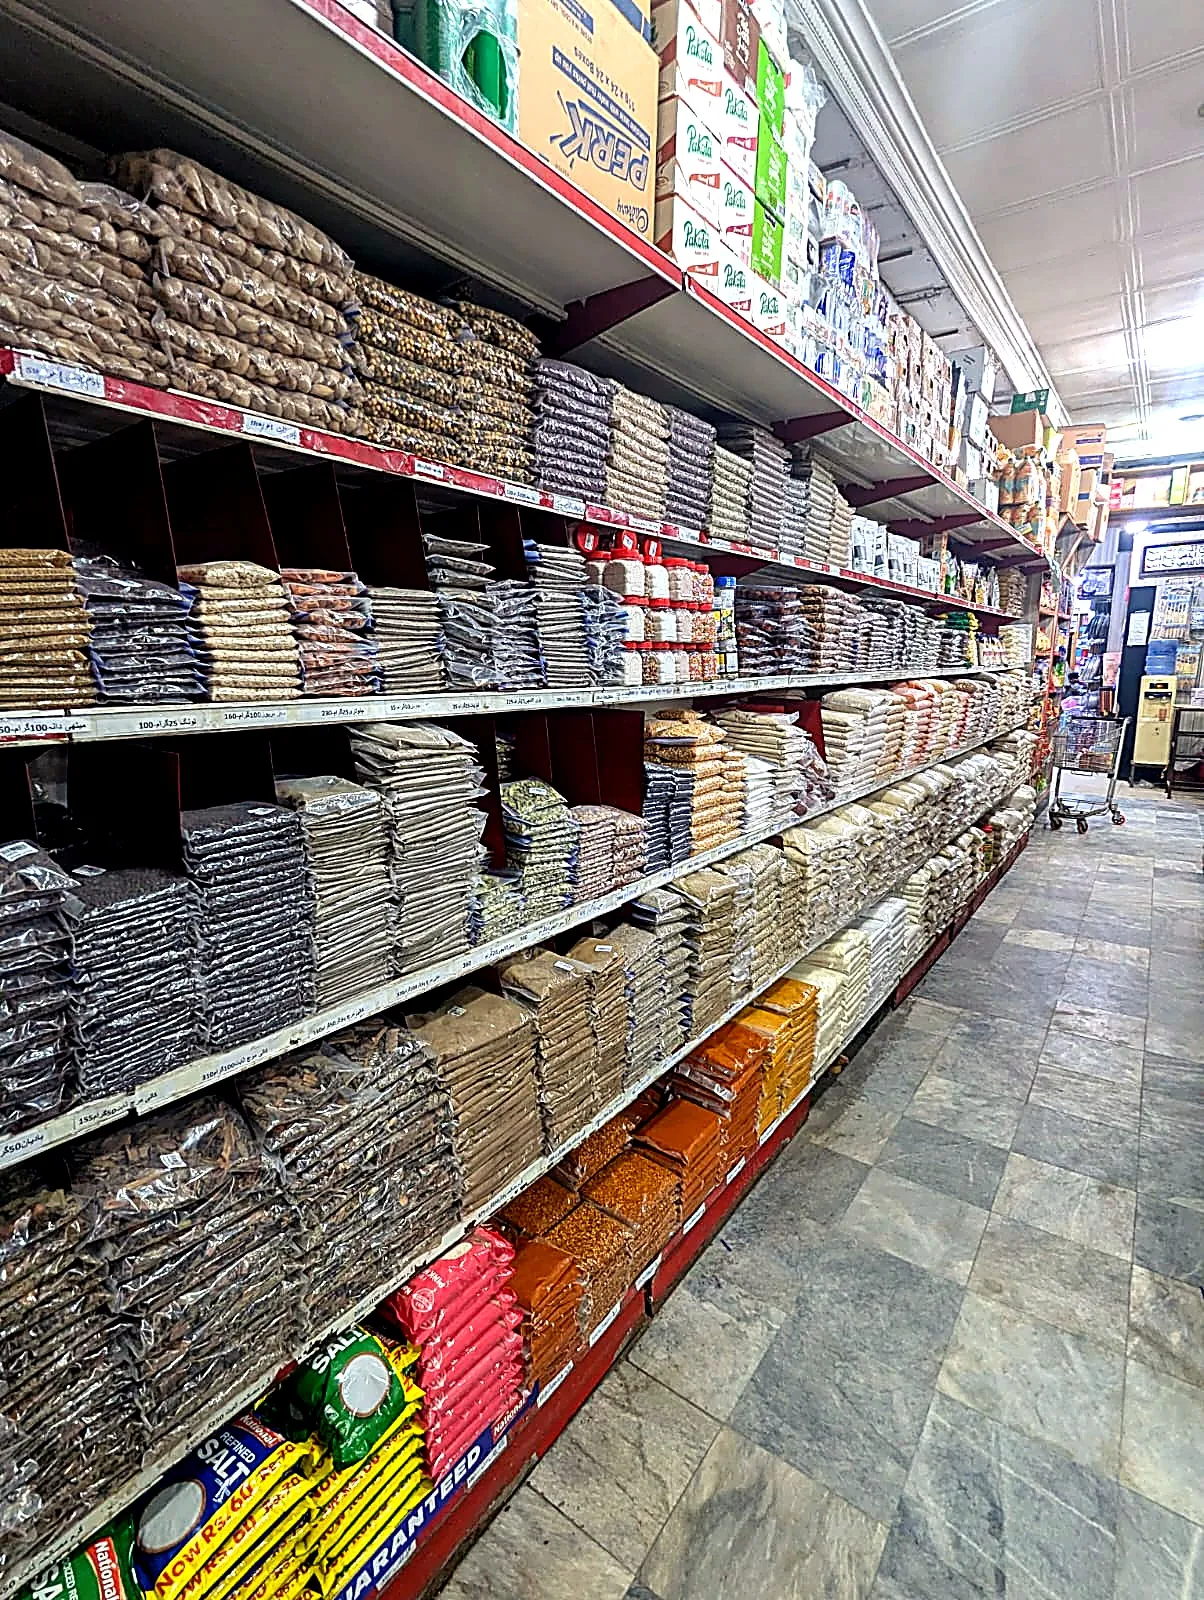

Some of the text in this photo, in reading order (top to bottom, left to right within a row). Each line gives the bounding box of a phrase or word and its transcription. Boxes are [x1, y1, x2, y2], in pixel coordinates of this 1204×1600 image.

[574, 46, 594, 74] Boxes
[685, 25, 713, 65] Pakola
[596, 68, 604, 84] 24
[611, 83, 618, 97] 24
[725, 88, 748, 122] Pakola
[559, 101, 649, 192] PERK
[686, 124, 713, 159] Pakola
[724, 181, 746, 209] Pakola
[616, 199, 649, 233] Cadbury
[683, 220, 710, 250] Pakola
[723, 263, 746, 289] Pakola
[759, 292, 779, 315] Pakola
[312, 1327, 370, 1374] SALT
[240, 1414, 278, 1445] National
[493, 1396, 526, 1437] National
[197, 1439, 250, 1487] SALT
[220, 1432, 256, 1463] REFINED
[94, 1541, 120, 1600] National
[155, 1540, 201, 1597] NOW
